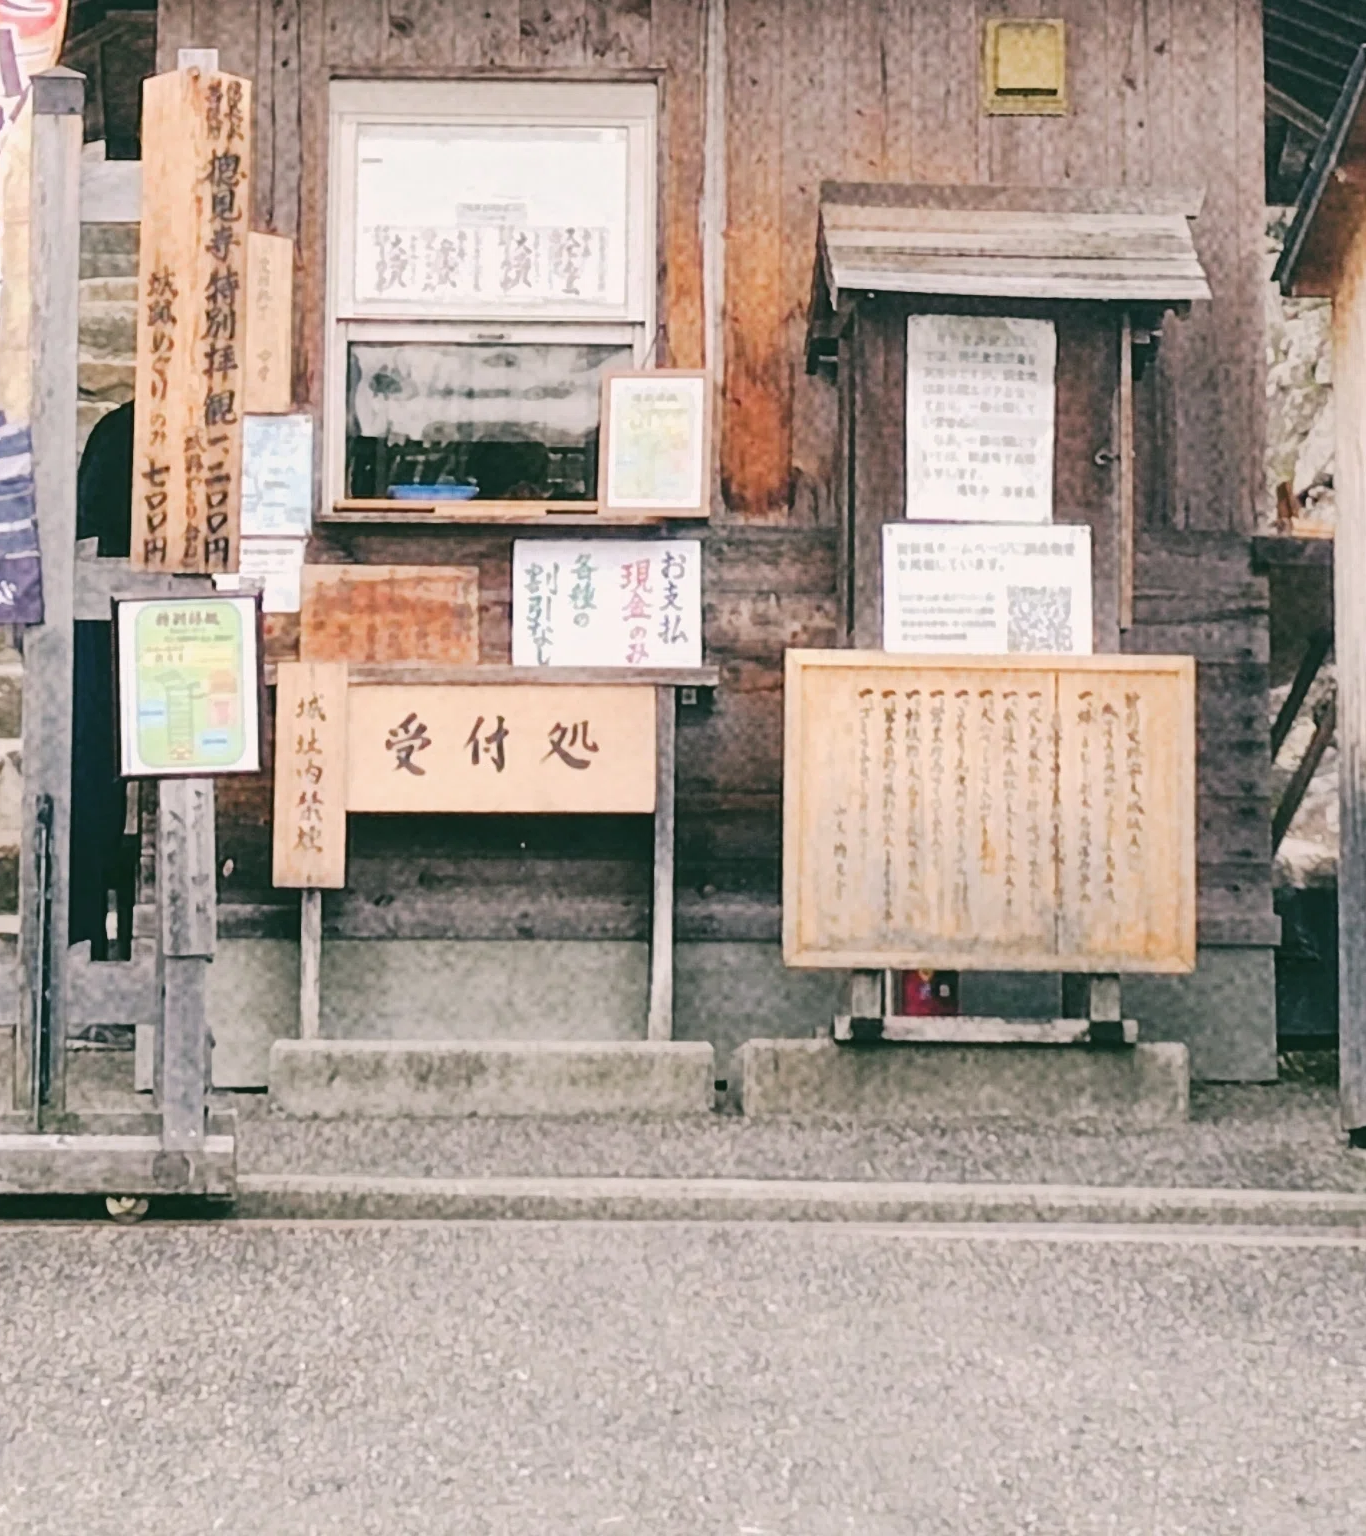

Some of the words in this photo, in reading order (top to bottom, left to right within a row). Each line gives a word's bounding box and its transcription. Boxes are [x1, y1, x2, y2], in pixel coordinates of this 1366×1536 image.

[620, 558, 653, 664] 現金のみ
[658, 550, 688, 644] お支払
[293, 691, 327, 854] 城址内禁煙
[385, 711, 599, 776] 受付処
